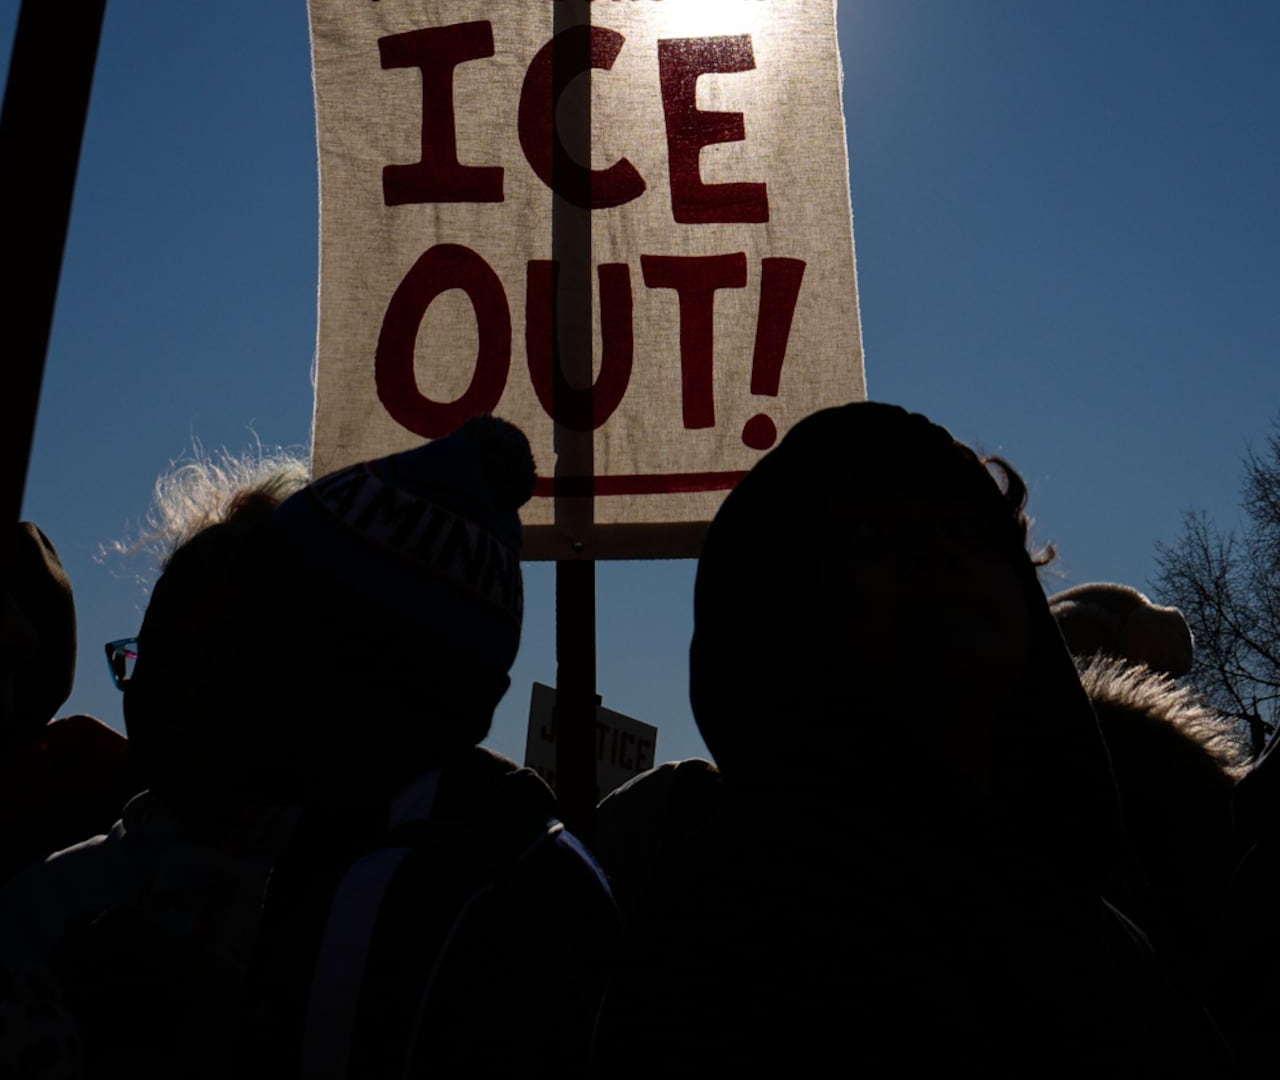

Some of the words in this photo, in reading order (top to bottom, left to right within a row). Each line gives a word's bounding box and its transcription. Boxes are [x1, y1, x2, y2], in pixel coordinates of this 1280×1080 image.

[378, 20, 770, 224] ICE
[375, 243, 807, 451] OUT!
[540, 706, 651, 772] JTICE
